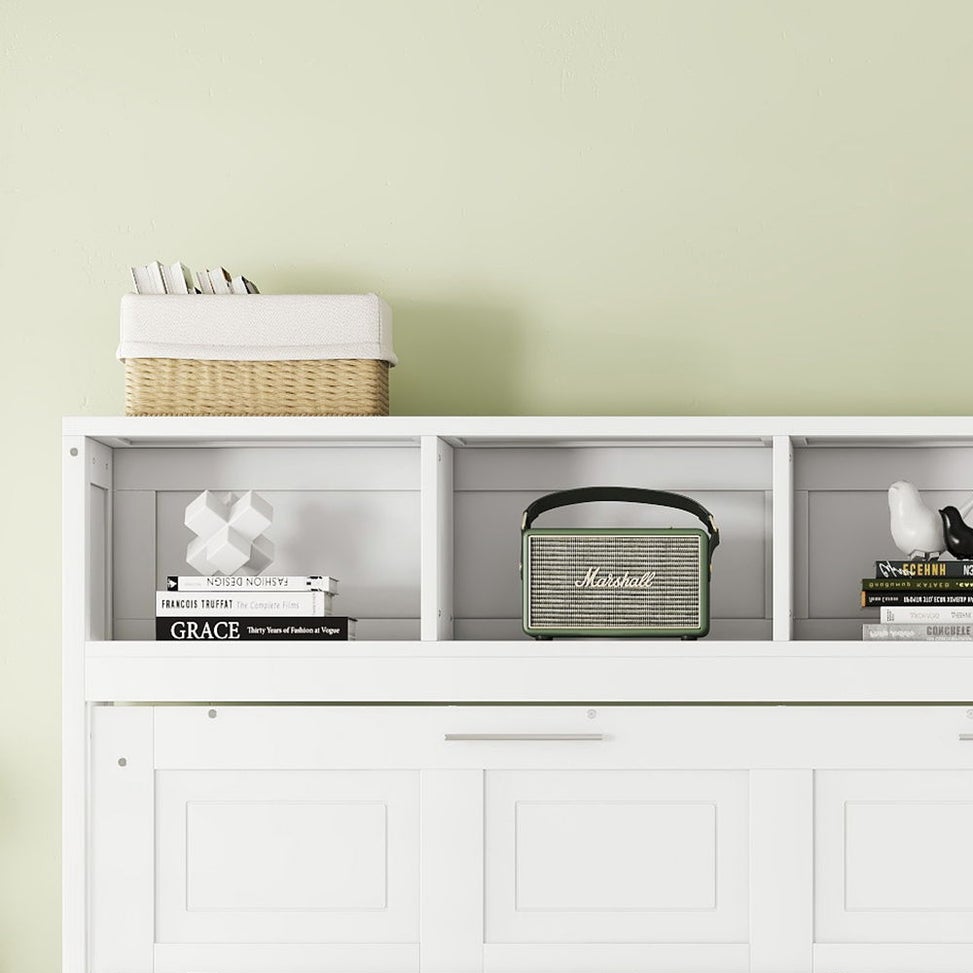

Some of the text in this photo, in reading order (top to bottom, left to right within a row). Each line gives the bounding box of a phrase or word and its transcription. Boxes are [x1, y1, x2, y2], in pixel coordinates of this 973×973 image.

[206, 577, 289, 587] FASHION DESIGN
[574, 566, 656, 589] Marshall
[170, 621, 341, 640] GRACE Thirty Years of Fashion at Vogue
